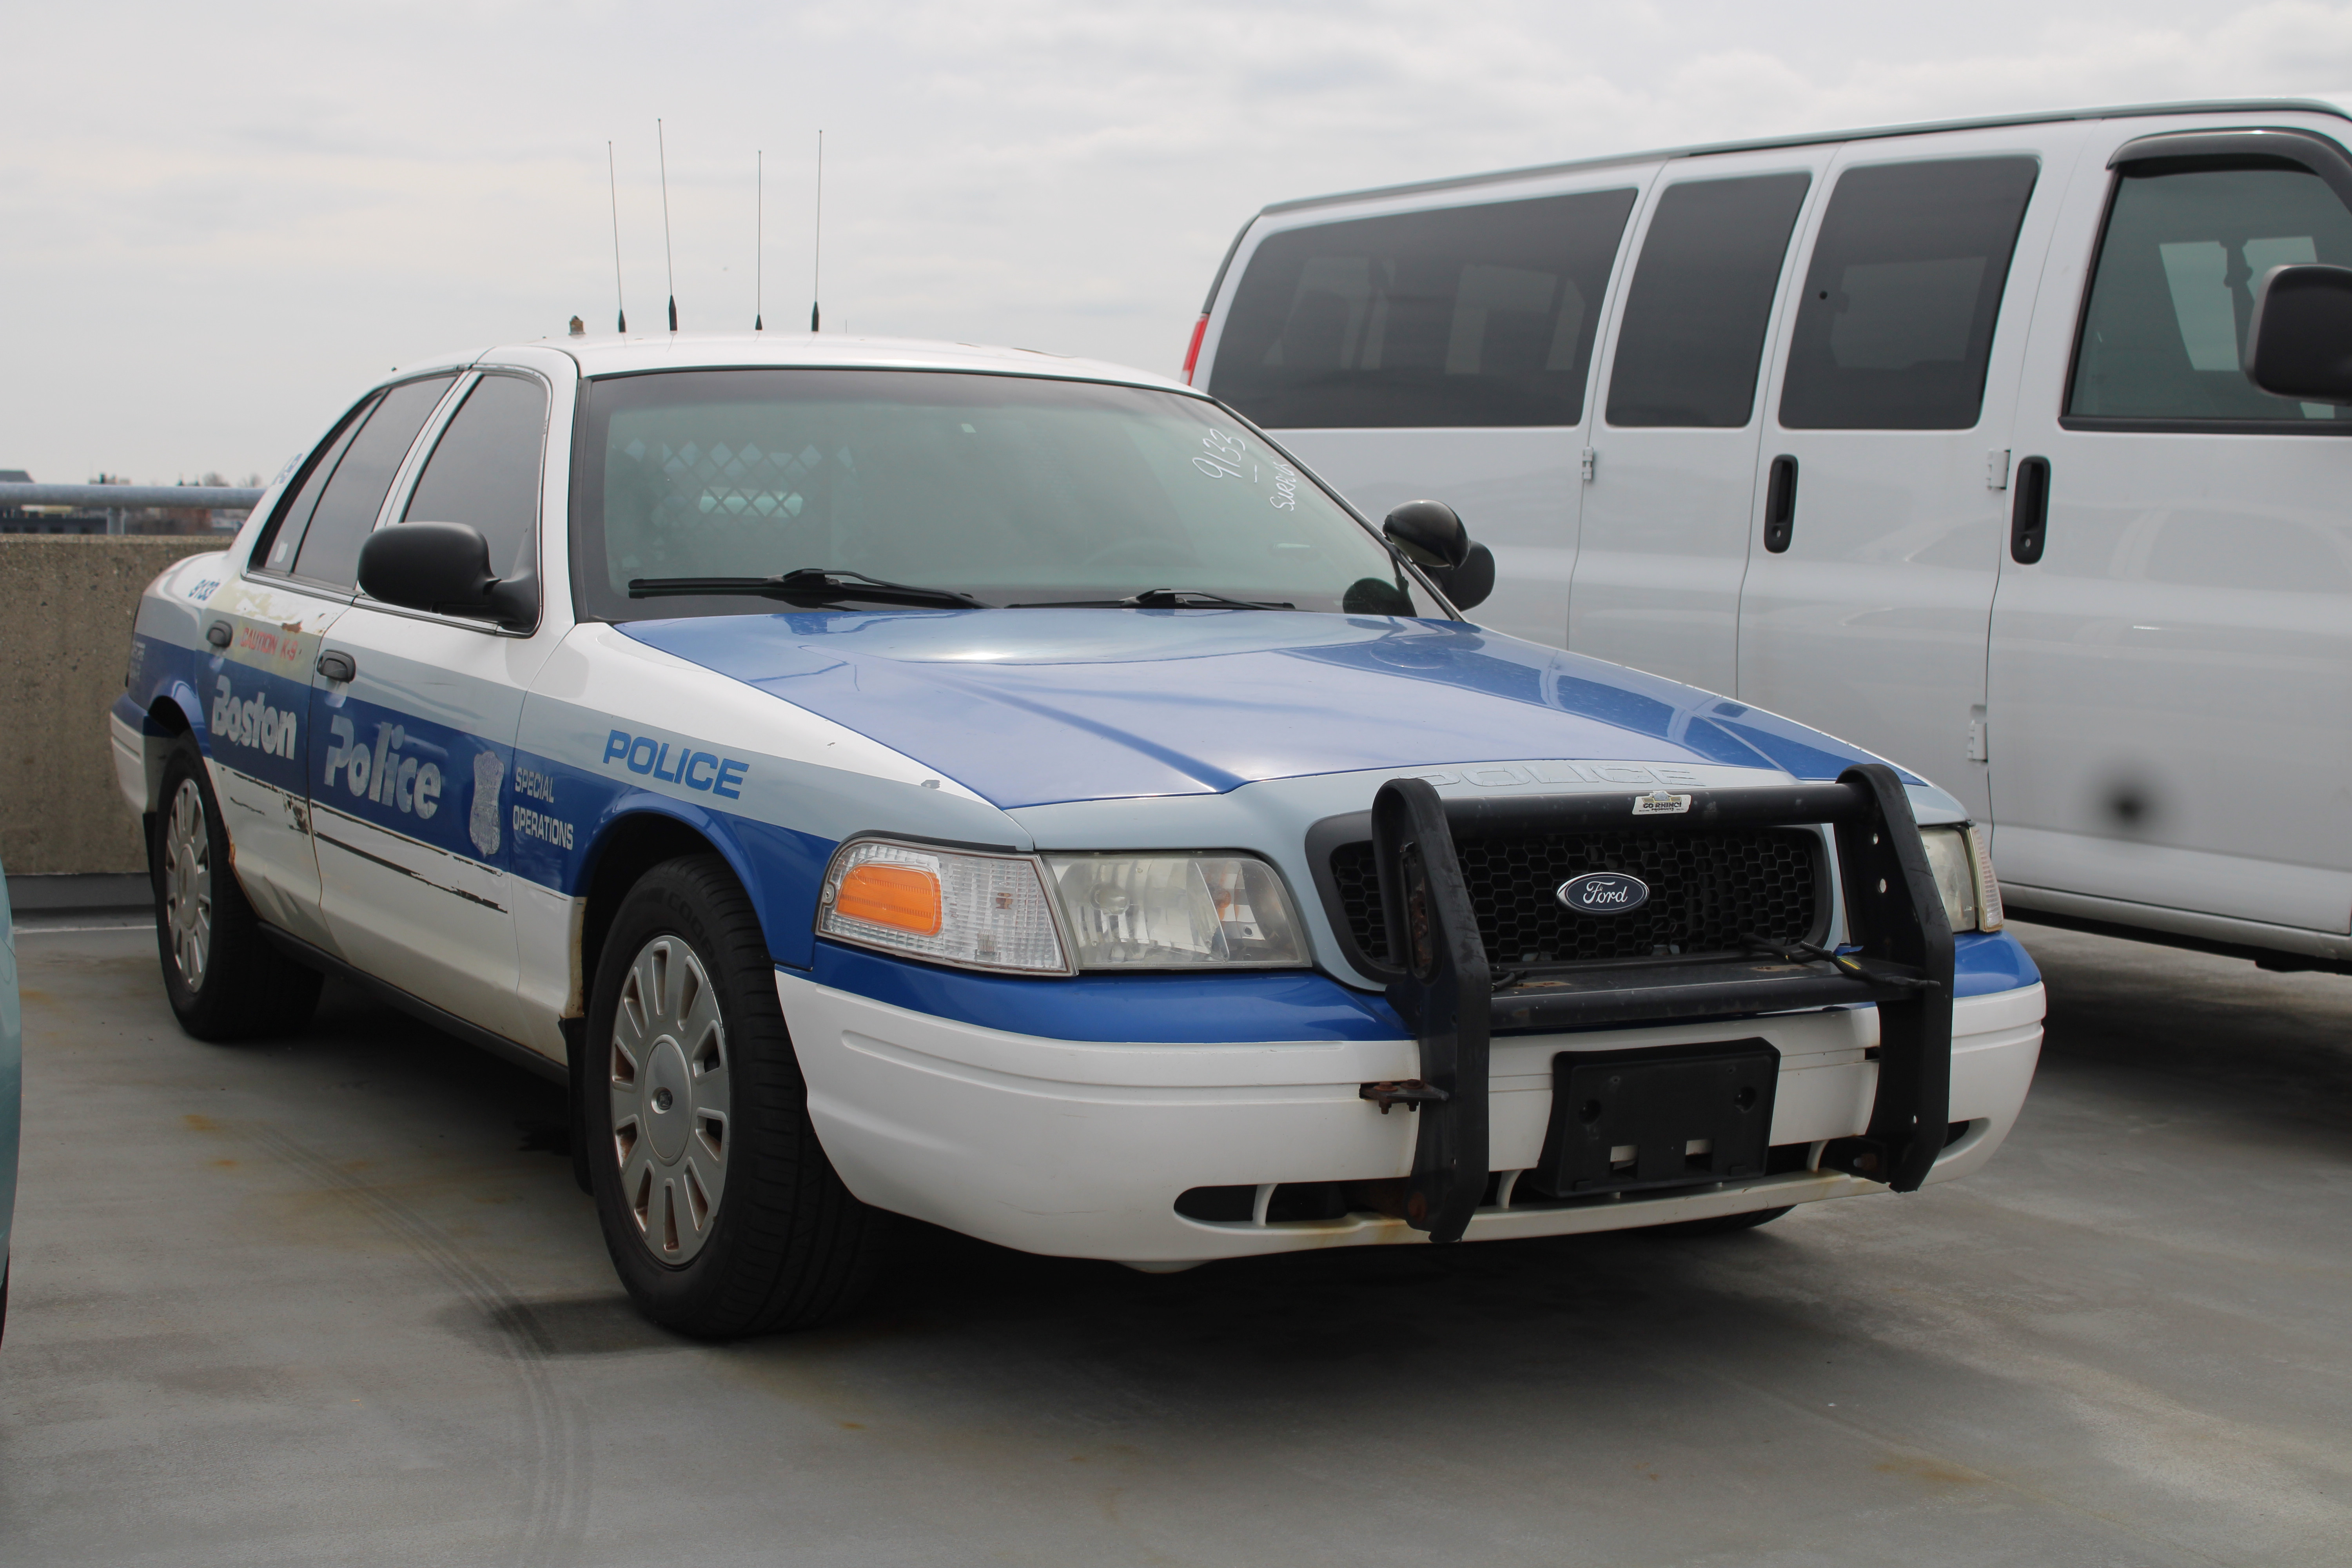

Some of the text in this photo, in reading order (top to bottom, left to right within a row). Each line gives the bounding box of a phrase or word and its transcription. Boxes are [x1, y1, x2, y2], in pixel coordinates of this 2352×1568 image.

[1192, 428, 1246, 479] 9133
[240, 627, 298, 661] CAUTION K-9
[211, 674, 441, 819] Boston Police
[603, 730, 750, 800] POLICE
[515, 766, 554, 803] SPECIAL
[513, 805, 573, 851] OPERATIONS
[1583, 881, 1628, 904] Ford
[668, 891, 731, 1017] COOPER
